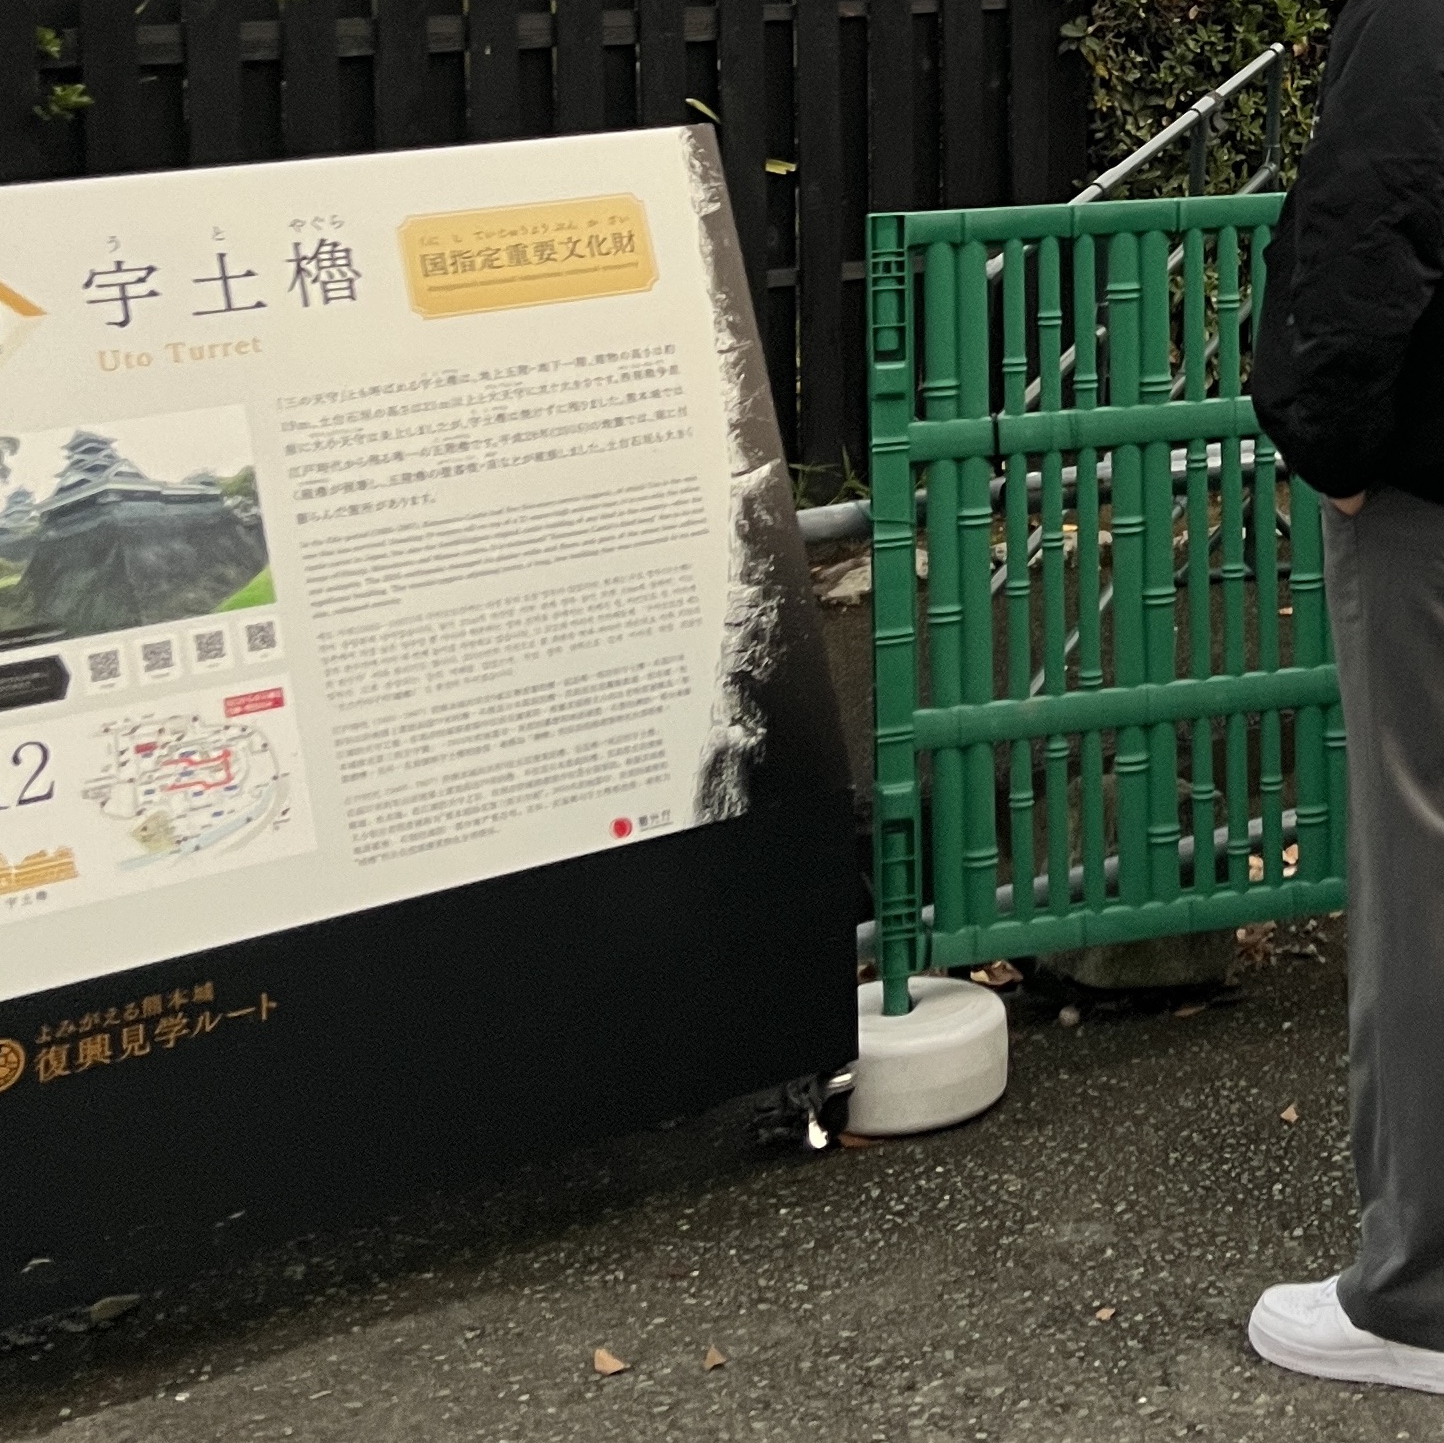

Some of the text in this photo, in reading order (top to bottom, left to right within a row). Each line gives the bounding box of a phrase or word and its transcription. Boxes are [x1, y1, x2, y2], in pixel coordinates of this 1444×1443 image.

[82, 237, 362, 328] 宇土櫓
[419, 229, 636, 278] 国指定重要文化財
[98, 336, 263, 372] Uto Turret
[34, 991, 277, 1083] 復興見学ルート
